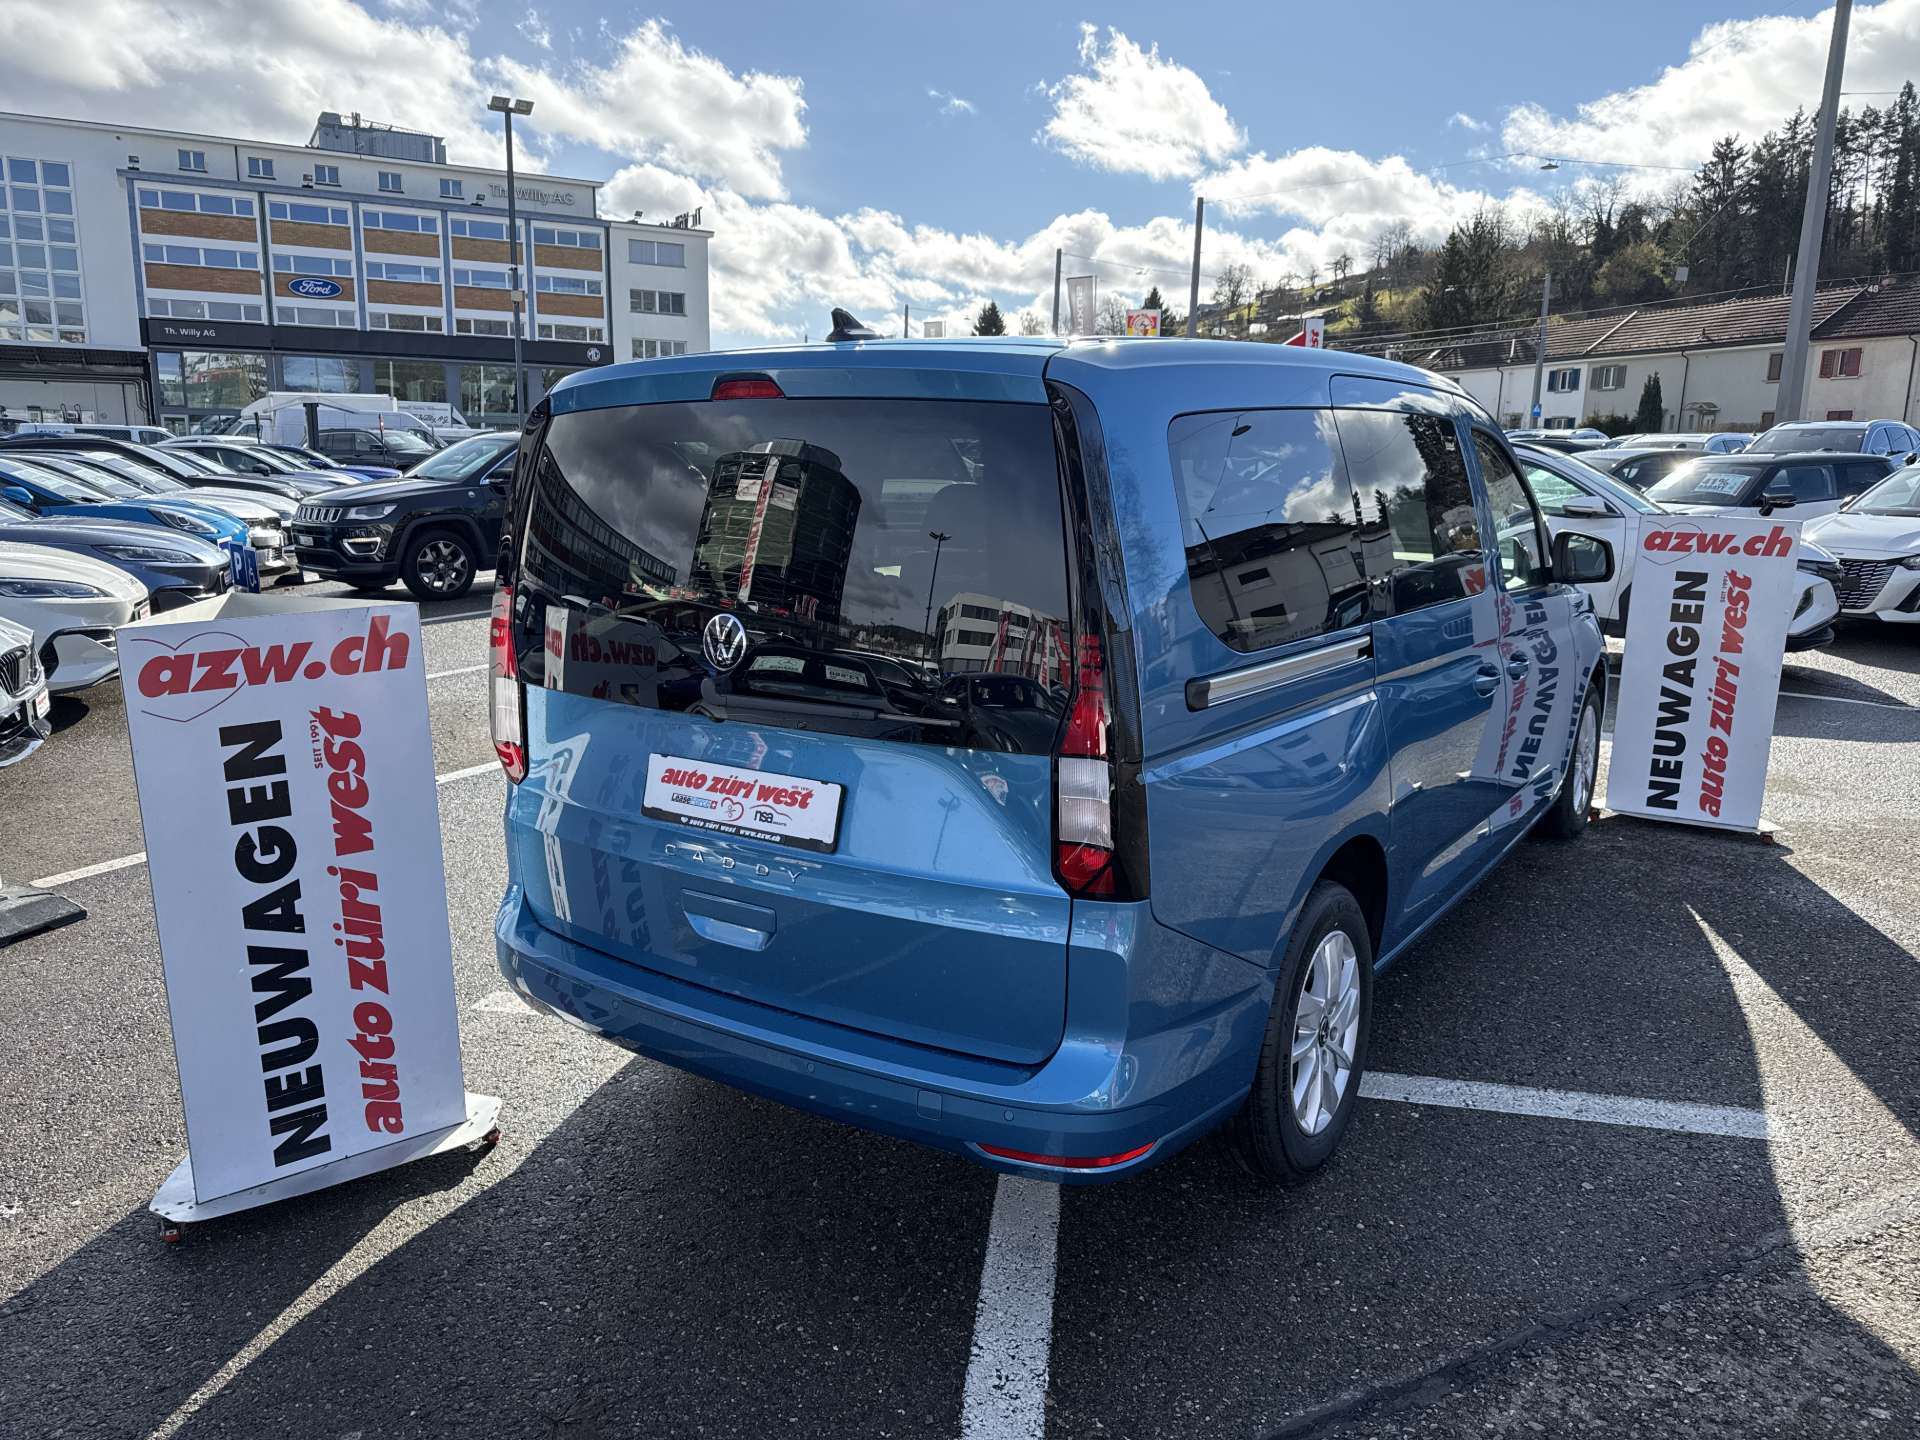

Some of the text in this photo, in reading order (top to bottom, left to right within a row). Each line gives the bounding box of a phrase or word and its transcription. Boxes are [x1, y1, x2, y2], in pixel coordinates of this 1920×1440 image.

[515, 186, 550, 207] Willy
[552, 191, 575, 206] AG
[299, 280, 332, 295] Ford
[164, 327, 216, 338] Th. Willy AG
[1643, 526, 1793, 558] azw.ch
[233, 551, 243, 580] P
[137, 615, 410, 698] azw.ch
[1645, 571, 1709, 810] NEUWAGEN
[1699, 569, 1753, 818] auto züri west
[309, 720, 324, 769] SEIT 1991
[661, 767, 815, 810] auto züri west
[753, 809, 774, 824] nsa
[664, 844, 809, 883] CADDY
[307, 705, 404, 1135] auto züri west
[218, 719, 333, 1167] NEUWAGEN
